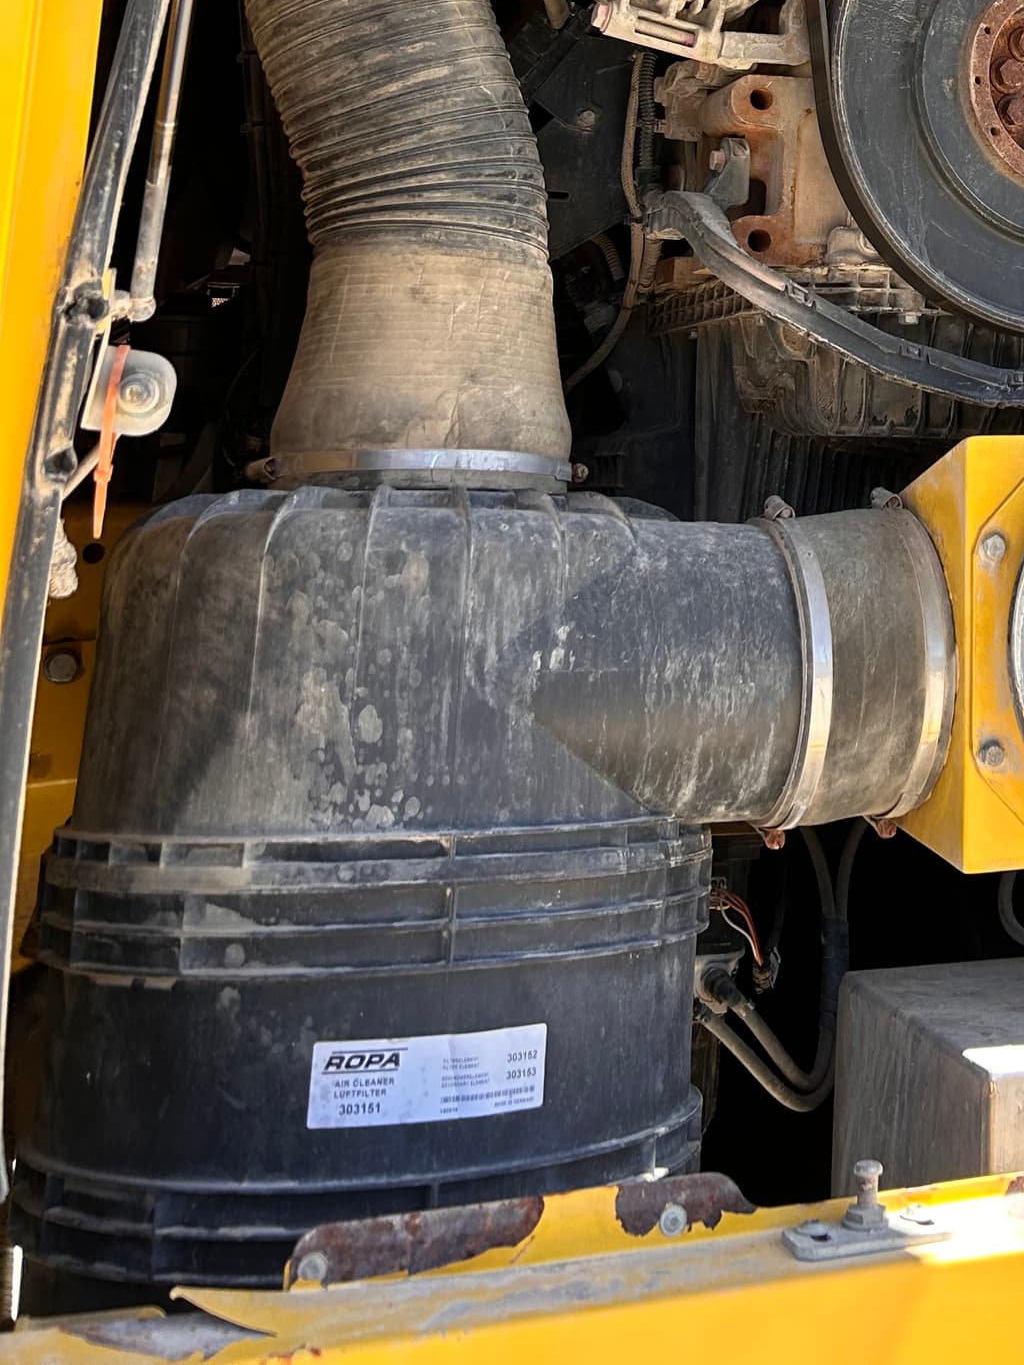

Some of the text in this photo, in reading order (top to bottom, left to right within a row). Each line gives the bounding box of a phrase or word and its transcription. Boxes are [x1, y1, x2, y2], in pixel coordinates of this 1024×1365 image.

[324, 1052, 400, 1071] ROPA
[335, 1077, 395, 1088] AIR CLEANER
[333, 1088, 387, 1099] LUFTFILTER
[339, 1102, 381, 1116] 303151
